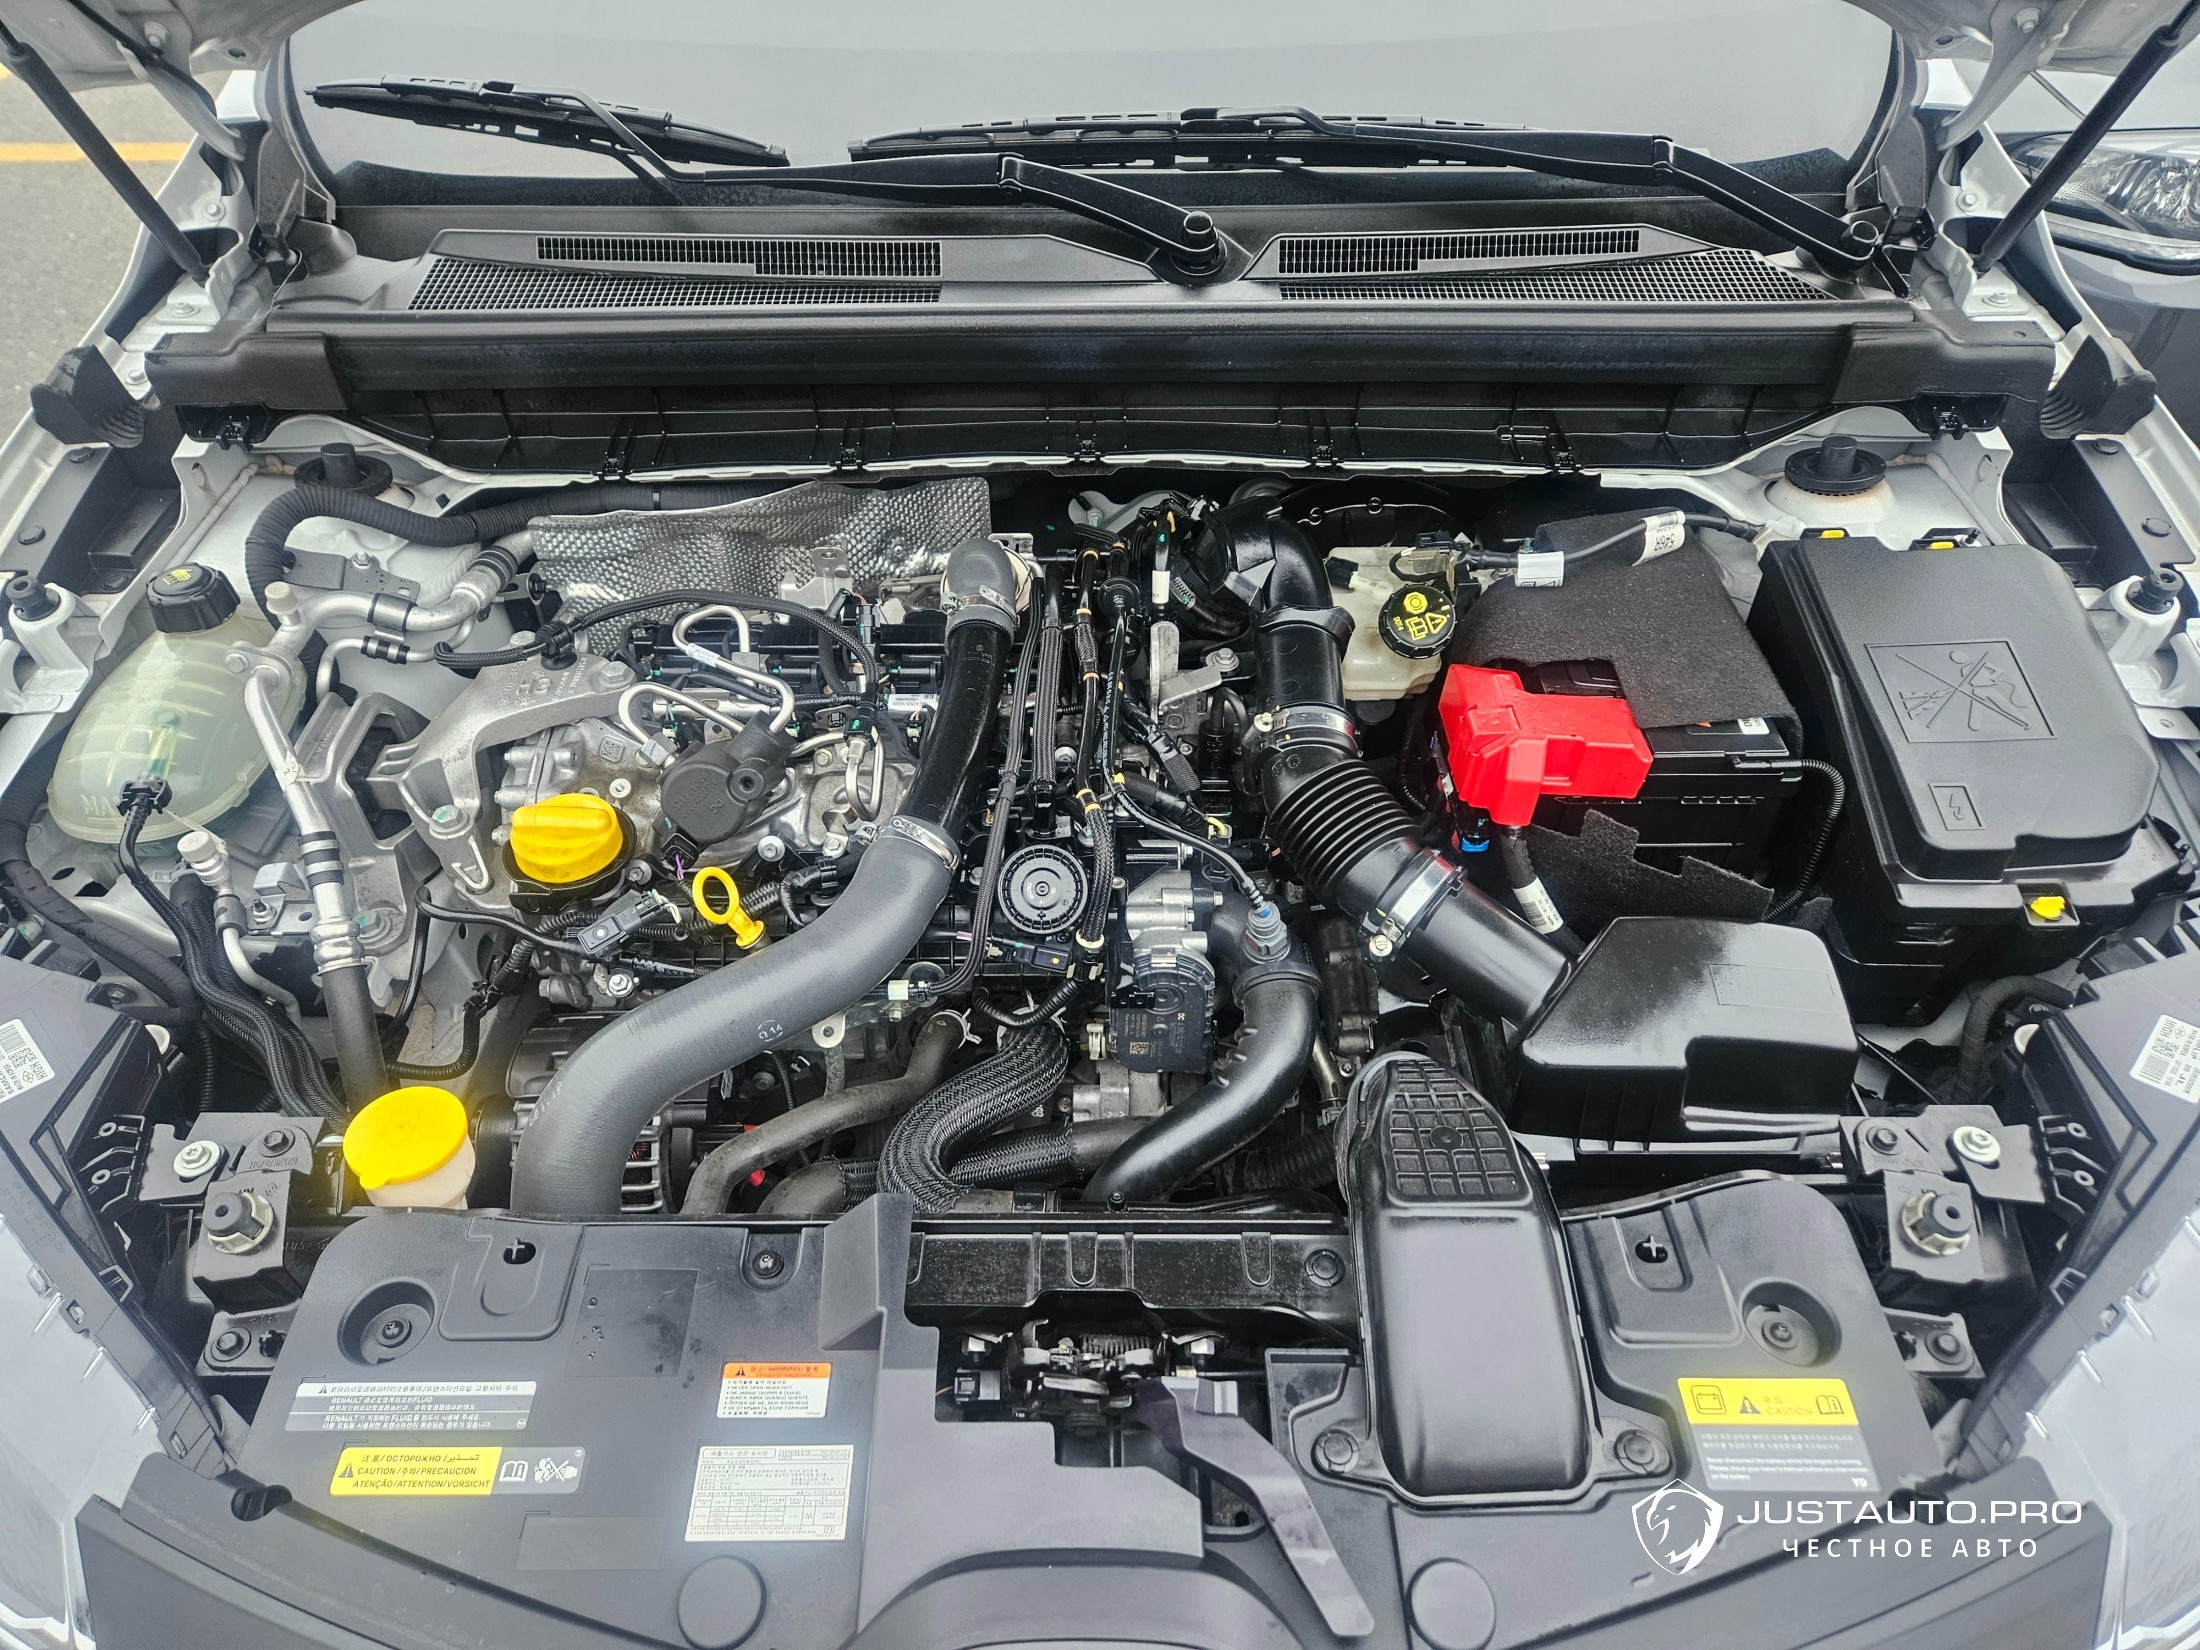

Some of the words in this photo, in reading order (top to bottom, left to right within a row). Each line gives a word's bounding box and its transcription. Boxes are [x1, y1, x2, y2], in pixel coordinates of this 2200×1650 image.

[2159, 1019, 2177, 1038] HIGH
[29, 1061, 48, 1080] HIGH
[1765, 1406, 1813, 1415] CAUTION
